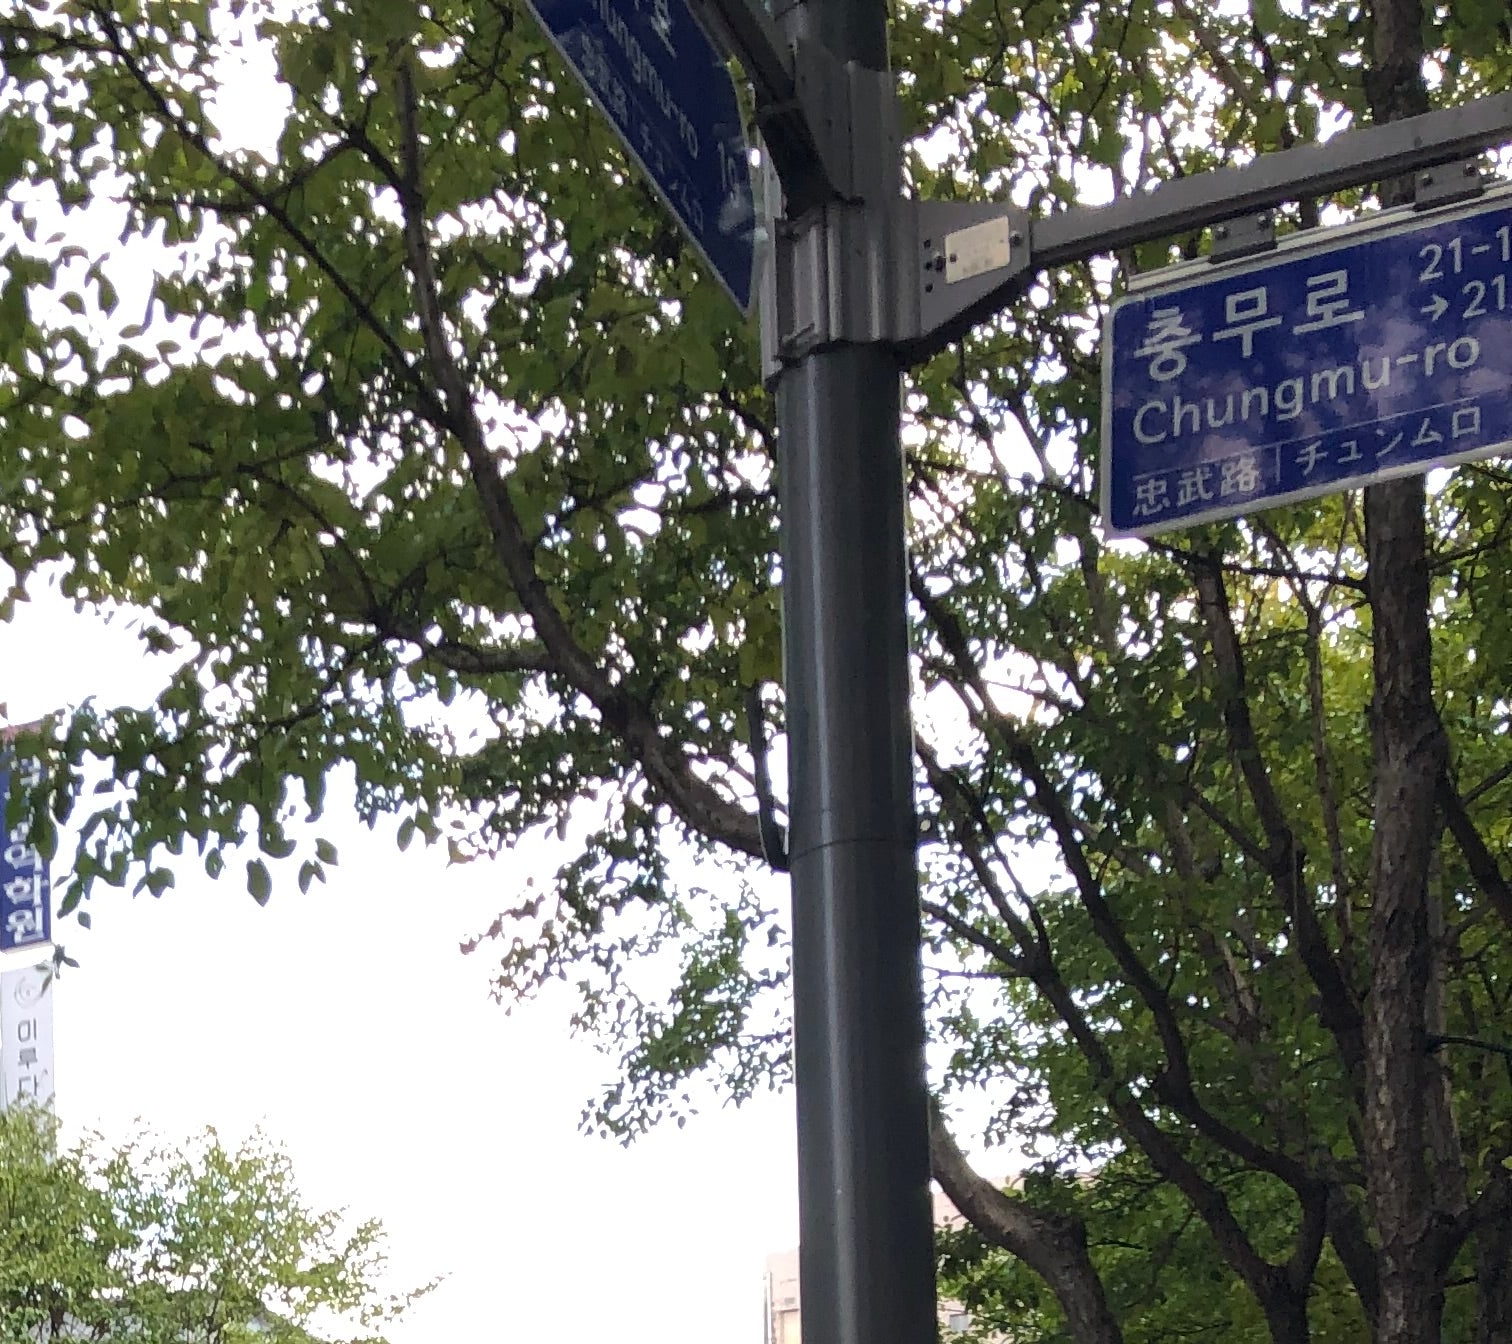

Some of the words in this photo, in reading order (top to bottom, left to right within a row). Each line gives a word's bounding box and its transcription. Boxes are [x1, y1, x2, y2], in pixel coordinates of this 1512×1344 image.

[1133, 269, 1365, 382] 충무로
[1132, 337, 1481, 445] Chungmu-ro
[1295, 406, 1481, 477] チュンムロ
[1132, 456, 1261, 517] 忠武路
